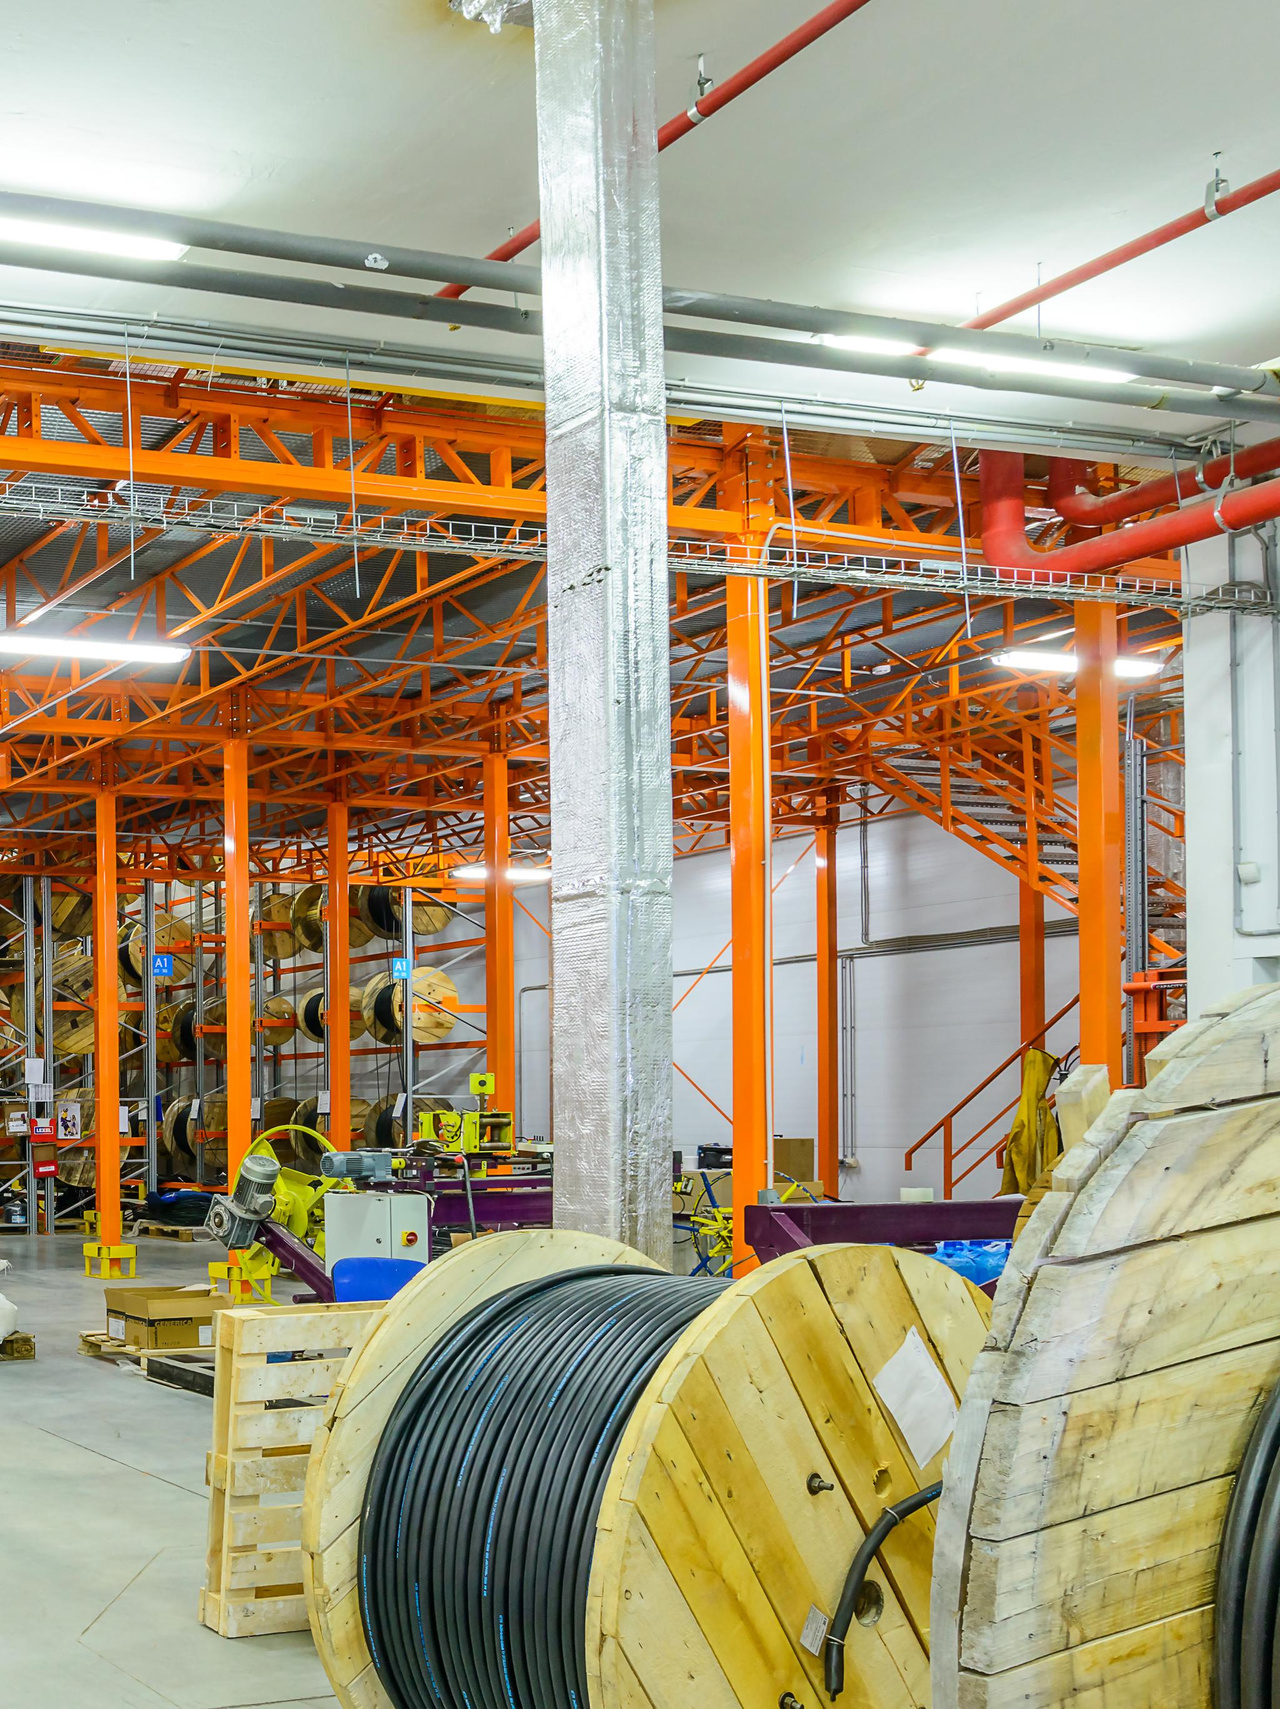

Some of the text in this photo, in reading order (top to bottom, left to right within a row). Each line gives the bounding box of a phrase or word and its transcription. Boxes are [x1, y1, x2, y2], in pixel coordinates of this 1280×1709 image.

[154, 957, 168, 968] A1
[394, 960, 407, 971] A1
[154, 1319, 193, 1328] GENERICA
